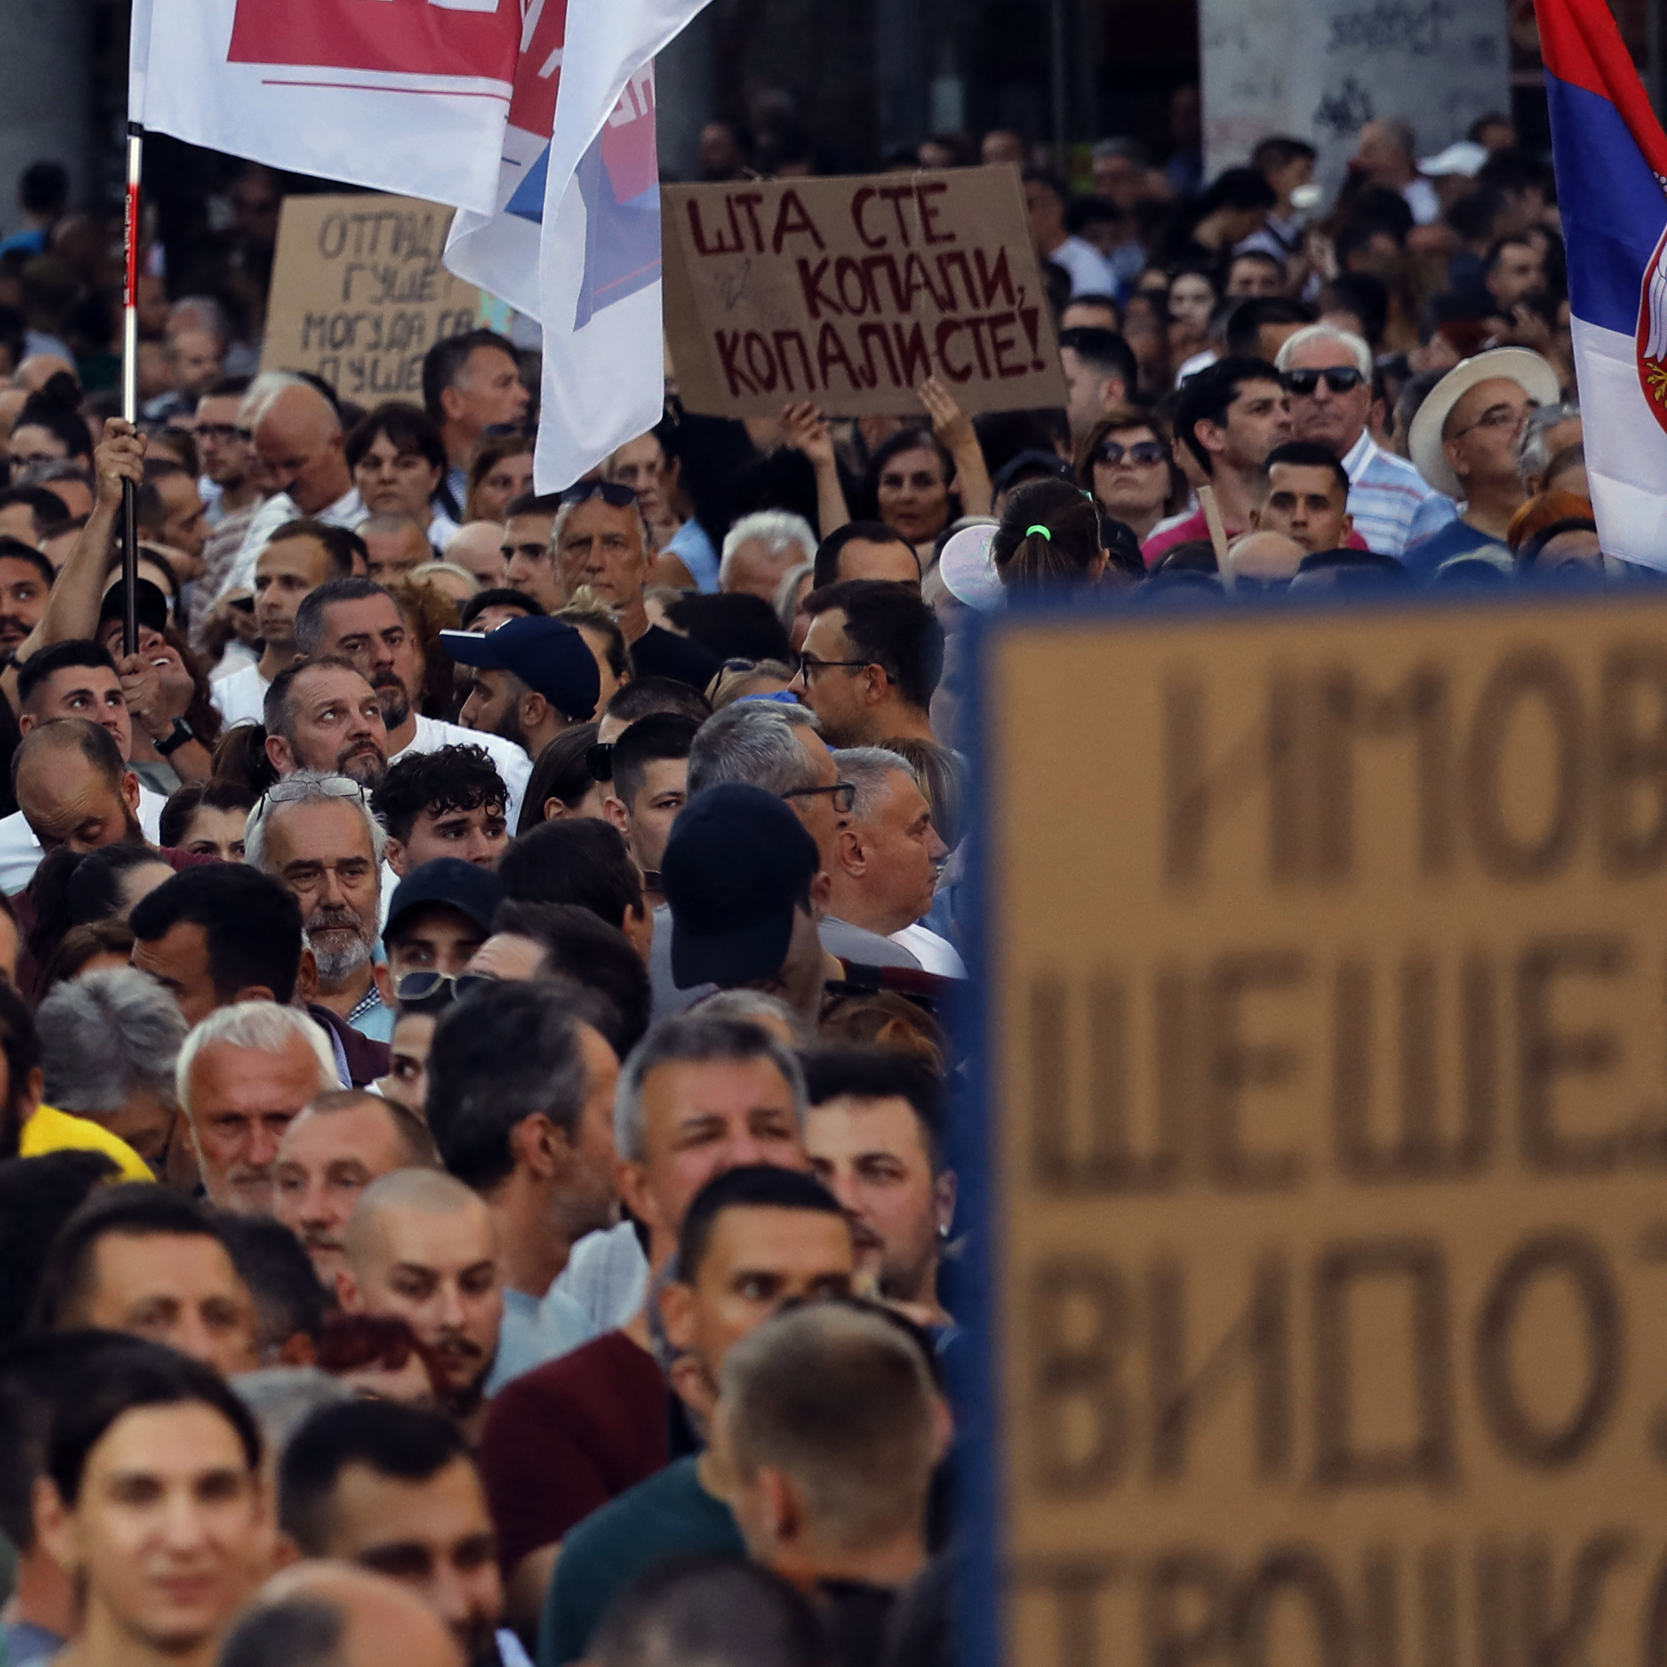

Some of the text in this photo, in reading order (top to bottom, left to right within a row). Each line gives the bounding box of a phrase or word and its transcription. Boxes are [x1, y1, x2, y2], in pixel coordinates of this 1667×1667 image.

[686, 181, 956, 257] ШТА СТЕ
[797, 245, 1028, 319] КОПАЛИ,
[1027, 934, 1667, 1196] ШЕШЕ
